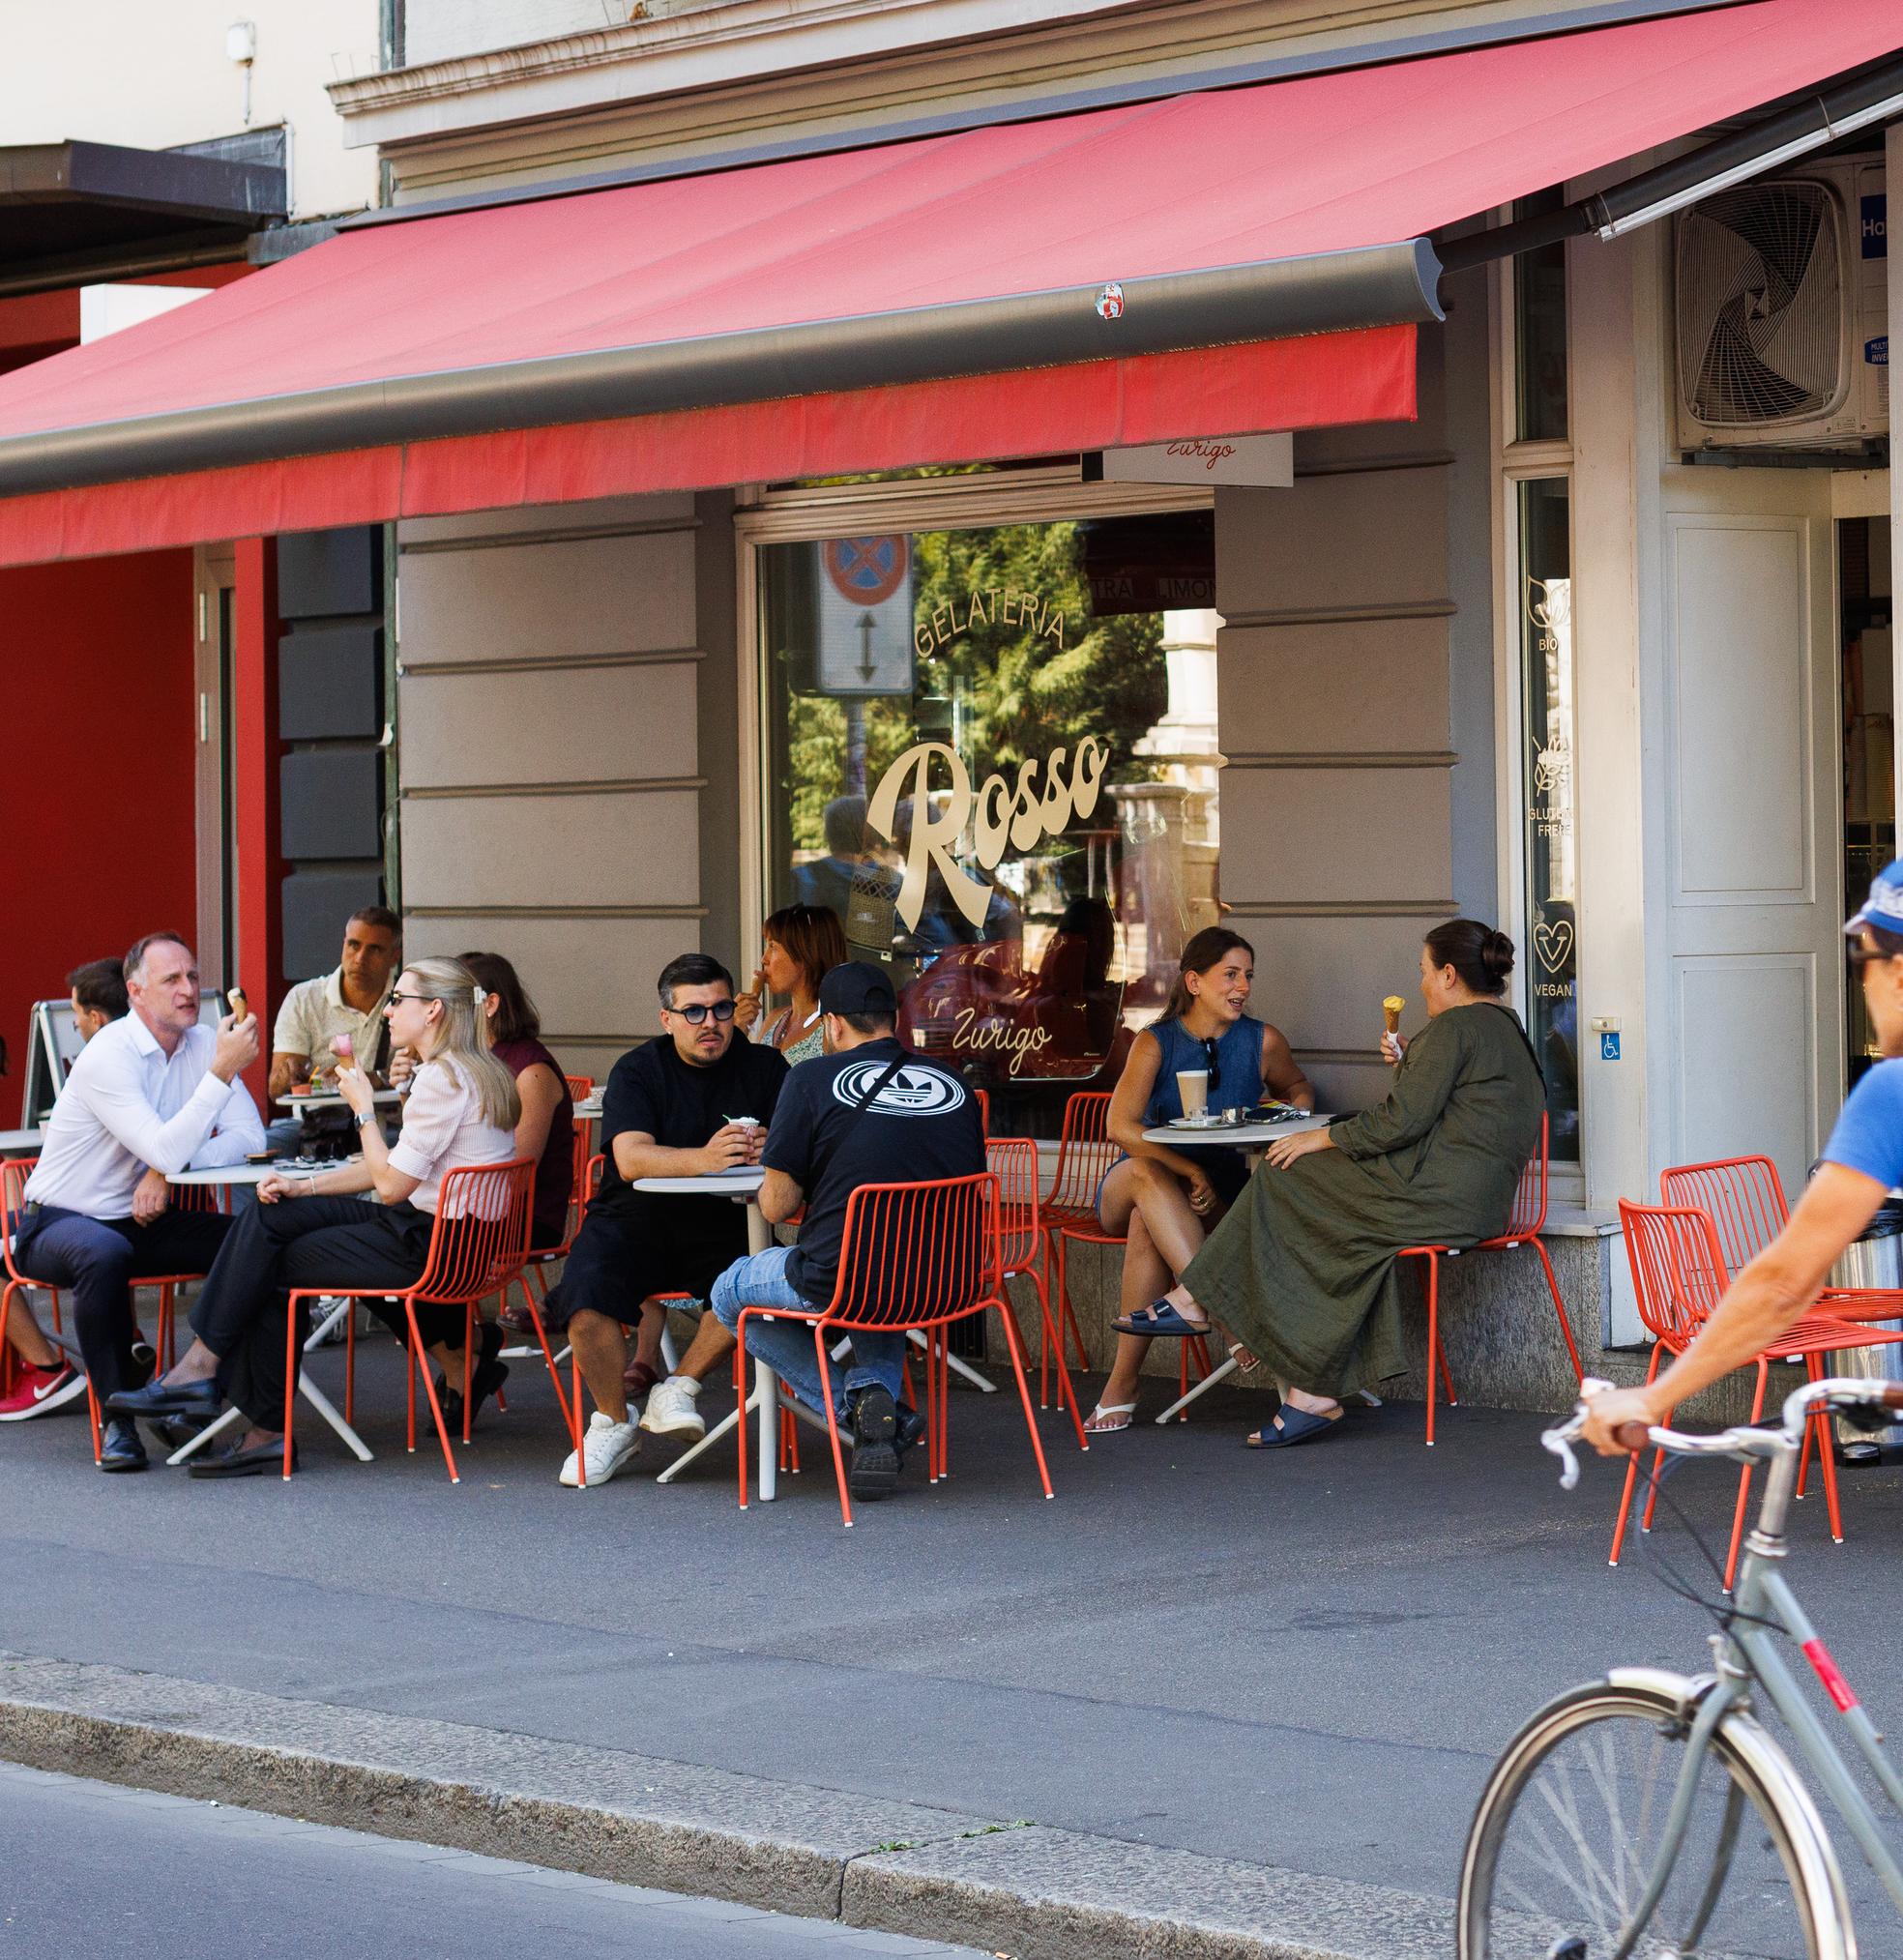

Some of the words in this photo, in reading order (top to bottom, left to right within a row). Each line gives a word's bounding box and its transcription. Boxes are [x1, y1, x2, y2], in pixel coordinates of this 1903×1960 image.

[1871, 353, 1888, 363] INVE
[914, 588, 1066, 658] GELATERIA
[1538, 638, 1558, 651] BIO
[1529, 807, 1570, 820] GLUTE
[866, 735, 1111, 934] Rosso
[1534, 983, 1572, 997] VEGAN
[953, 1007, 1053, 1074] Zurigo
